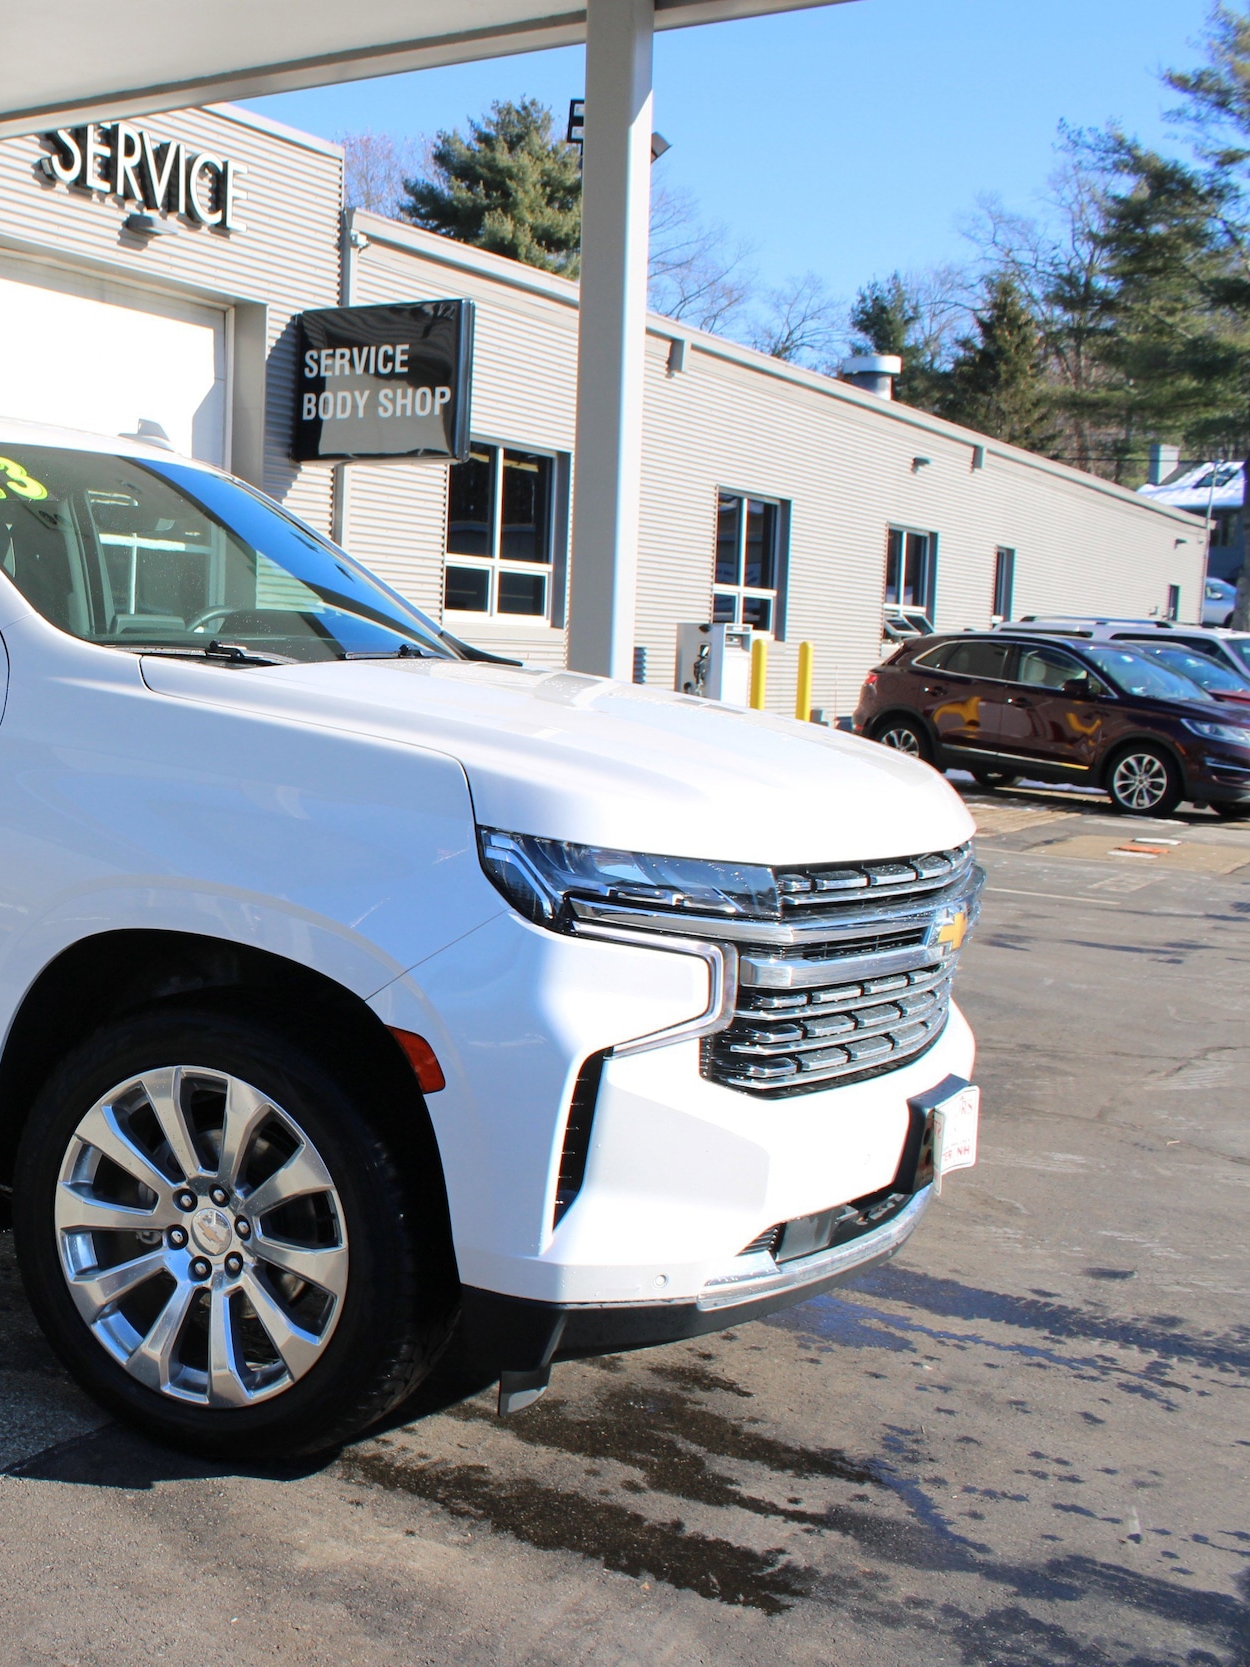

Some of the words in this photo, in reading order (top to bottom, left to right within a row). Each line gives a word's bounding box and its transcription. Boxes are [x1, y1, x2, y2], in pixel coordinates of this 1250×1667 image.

[49, 122, 248, 232] SERVICE
[304, 344, 410, 378] SERVICE
[302, 390, 370, 420] BODY
[378, 386, 451, 418] SHOP
